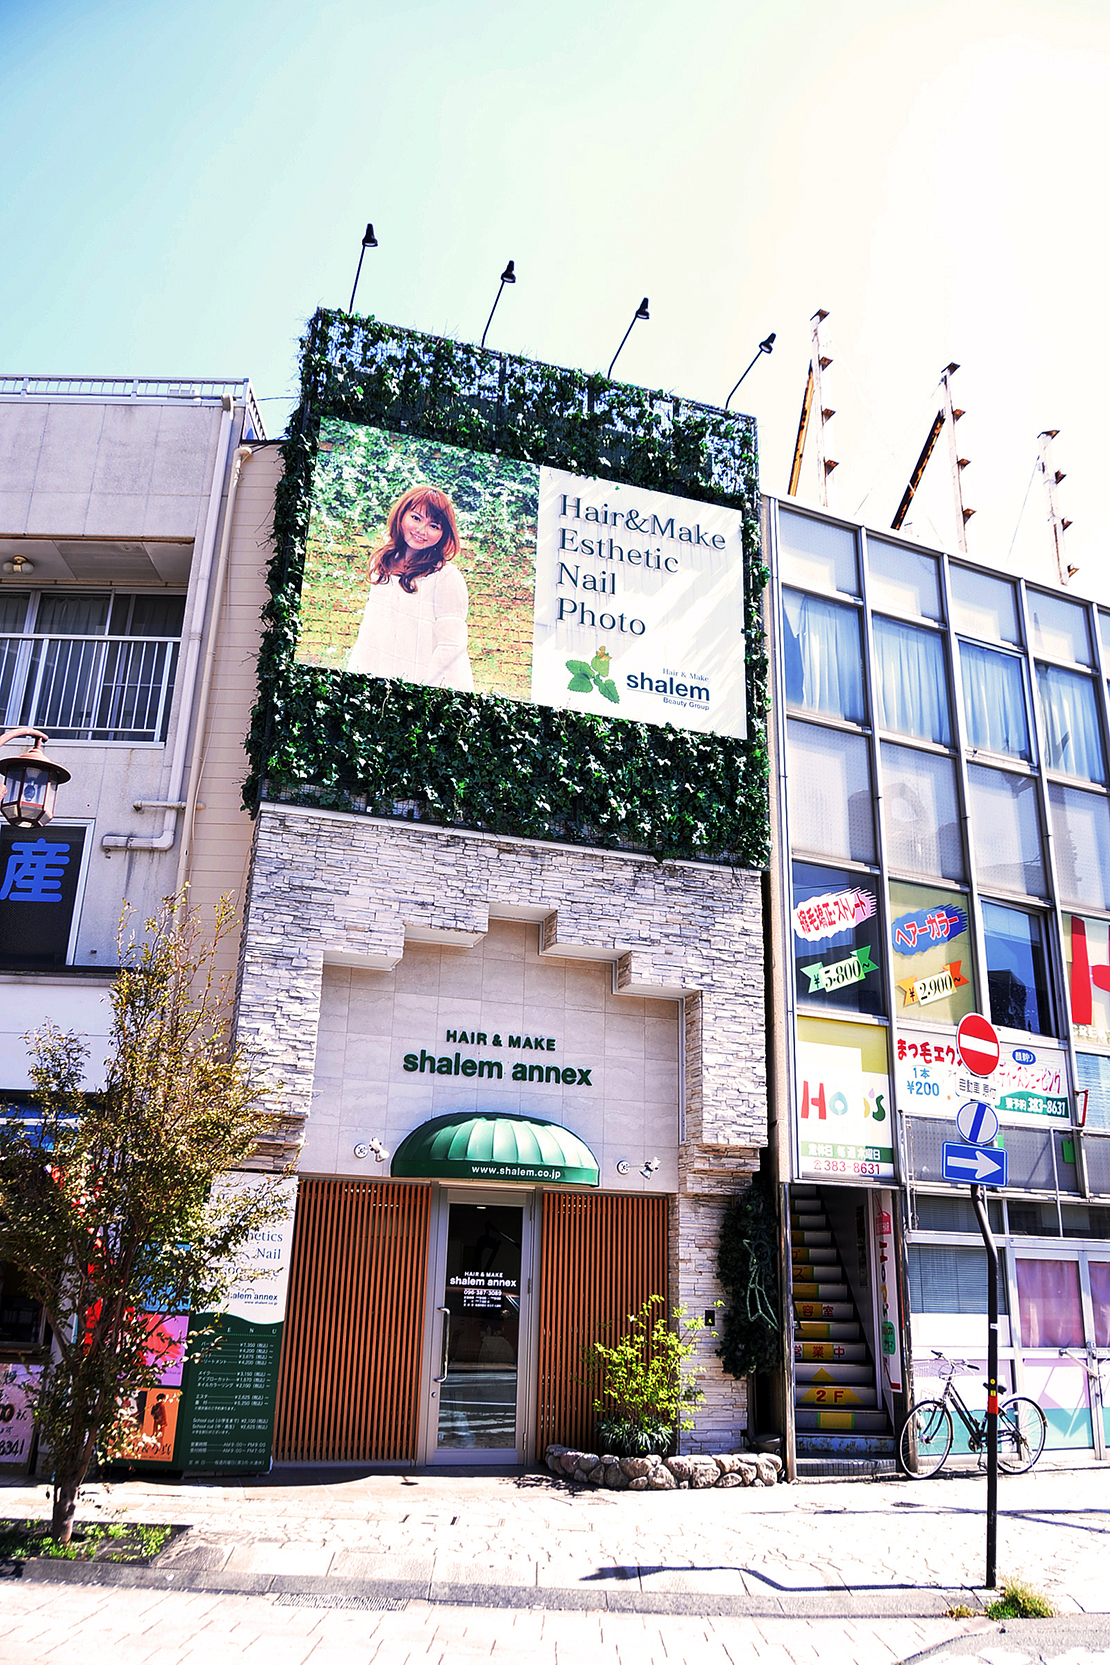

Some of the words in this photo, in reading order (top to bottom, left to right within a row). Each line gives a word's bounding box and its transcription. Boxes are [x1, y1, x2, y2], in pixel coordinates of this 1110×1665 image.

[560, 494, 726, 550] Hair&Make
[559, 527, 679, 573] Esthetic
[558, 562, 616, 595] Nail
[557, 597, 646, 636] Photo
[663, 668, 678, 676] Hair
[690, 673, 709, 681] Make
[626, 672, 710, 701] shalem
[663, 697, 687, 708] Beauty
[689, 702, 710, 711] Group
[0, 838, 70, 902] 産
[895, 910, 959, 947] ヘアーカラー
[446, 1030, 487, 1045] HAIR
[492, 1034, 503, 1047] &
[508, 1035, 556, 1051] MAKE
[403, 1049, 503, 1079] shalem
[512, 1062, 592, 1086] annex
[907, 1080, 940, 1096] ¥200
[471, 1166, 561, 1180] www.shalem.co.jp
[824, 1160, 880, 1175] 383-8631
[256, 1248, 281, 1260] Nail
[449, 1276, 485, 1286] shalem
[487, 1279, 517, 1287] annex
[254, 1293, 278, 1301] annex
